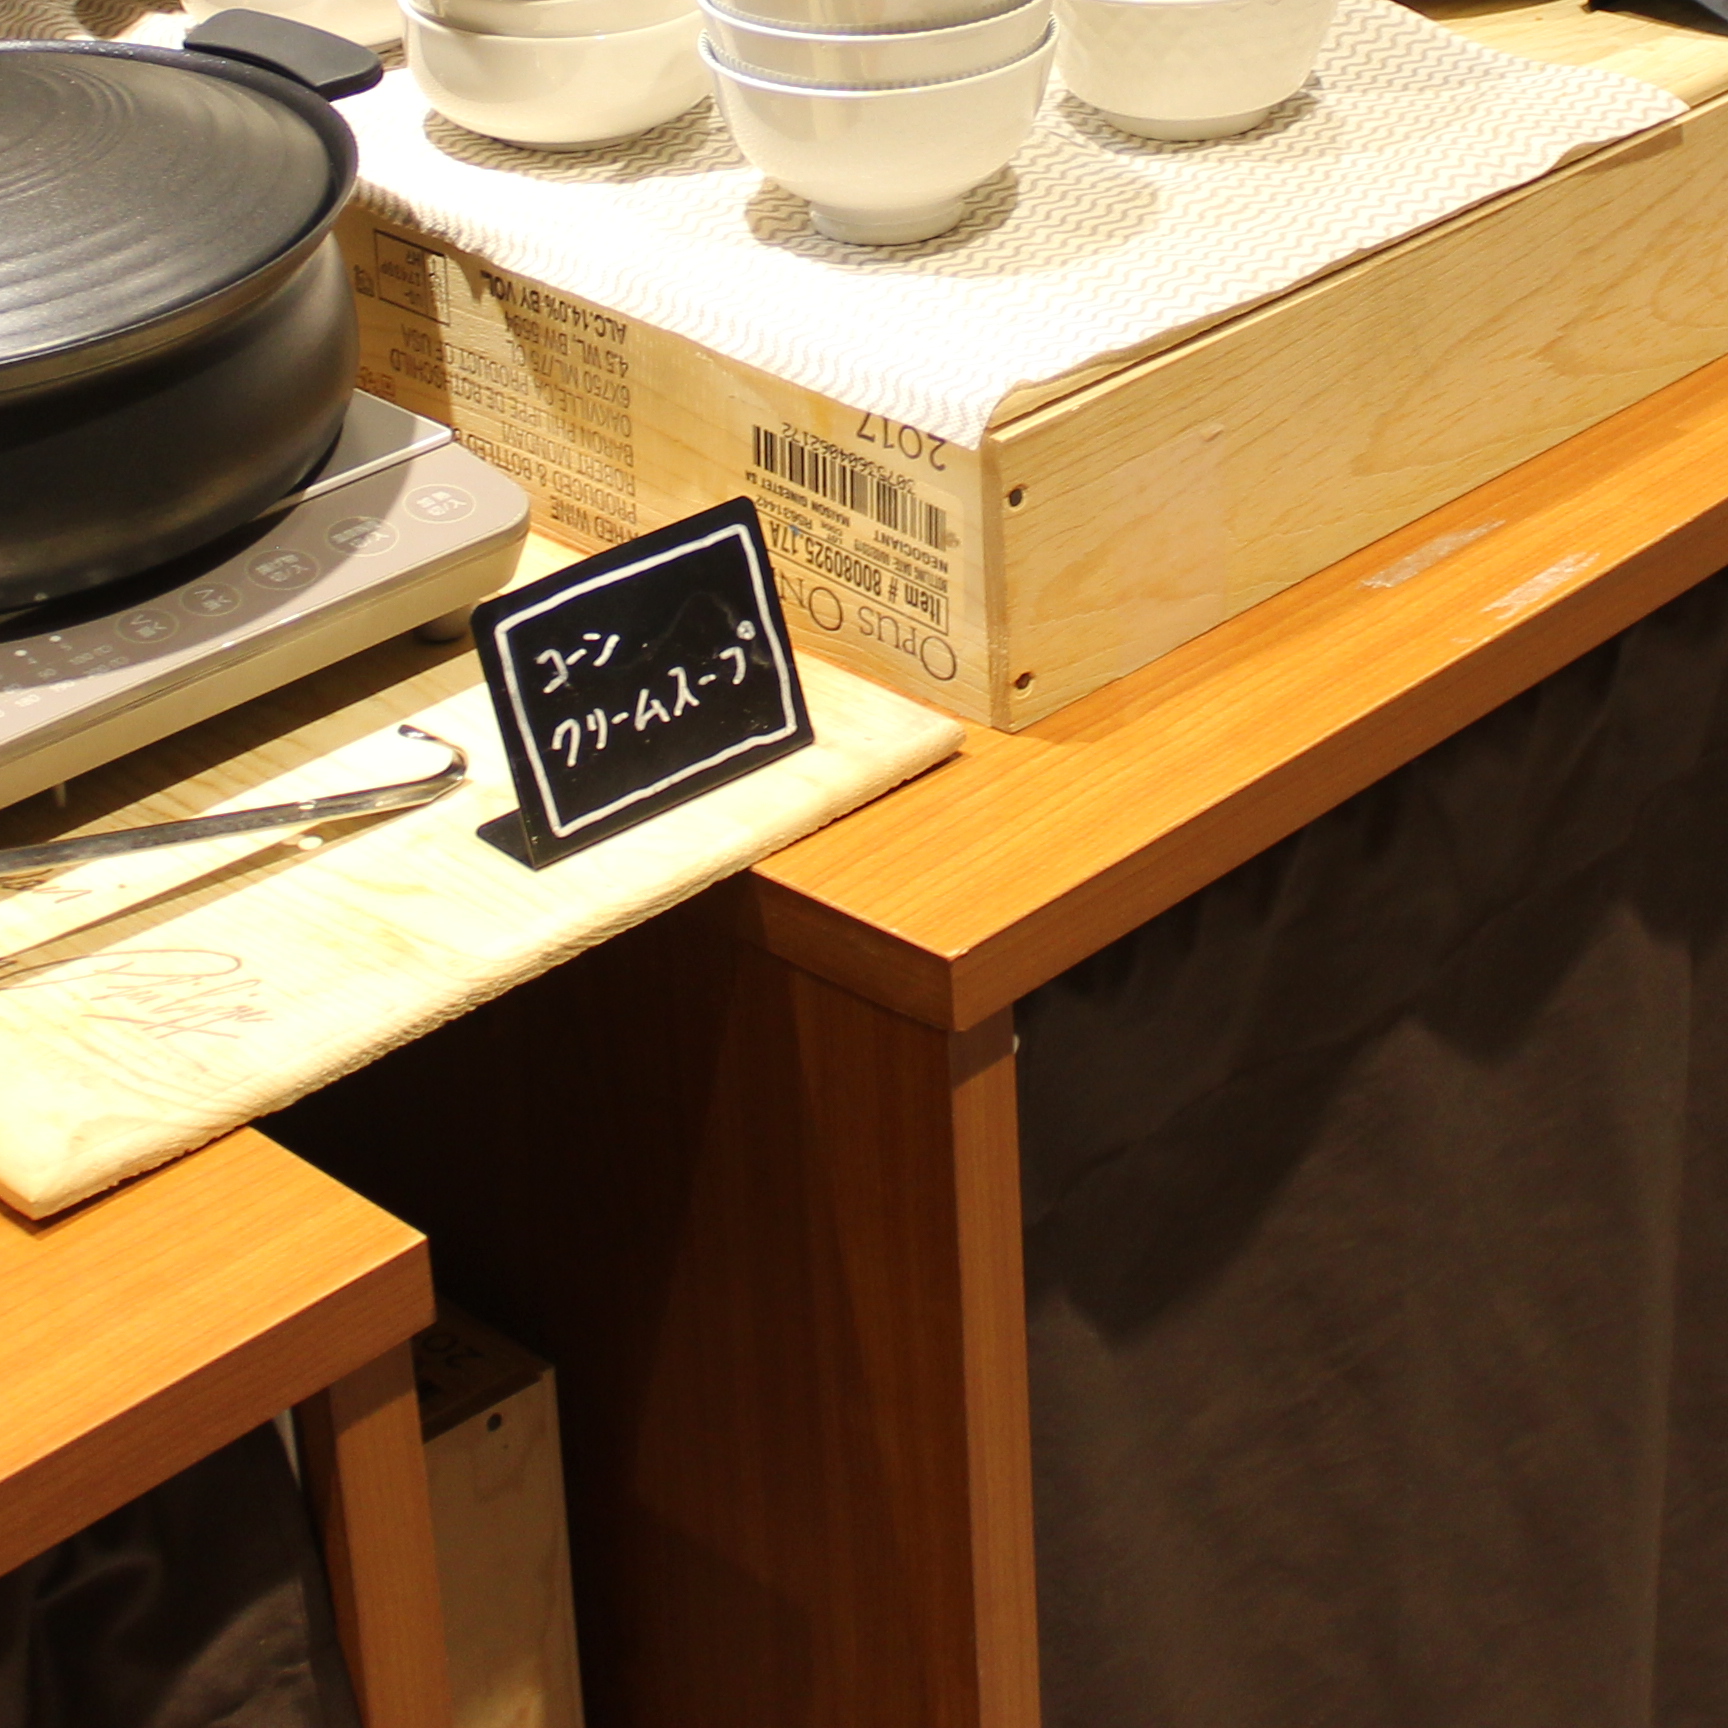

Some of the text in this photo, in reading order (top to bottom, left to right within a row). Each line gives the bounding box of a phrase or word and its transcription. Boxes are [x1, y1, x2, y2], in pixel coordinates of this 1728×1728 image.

[857, 412, 947, 471] 2017
[552, 471, 638, 523] PRODUCED
[888, 578, 899, 605] #
[905, 583, 942, 625] Item
[772, 566, 957, 682] OPUS ON
[551, 619, 757, 768] クリームスープ
